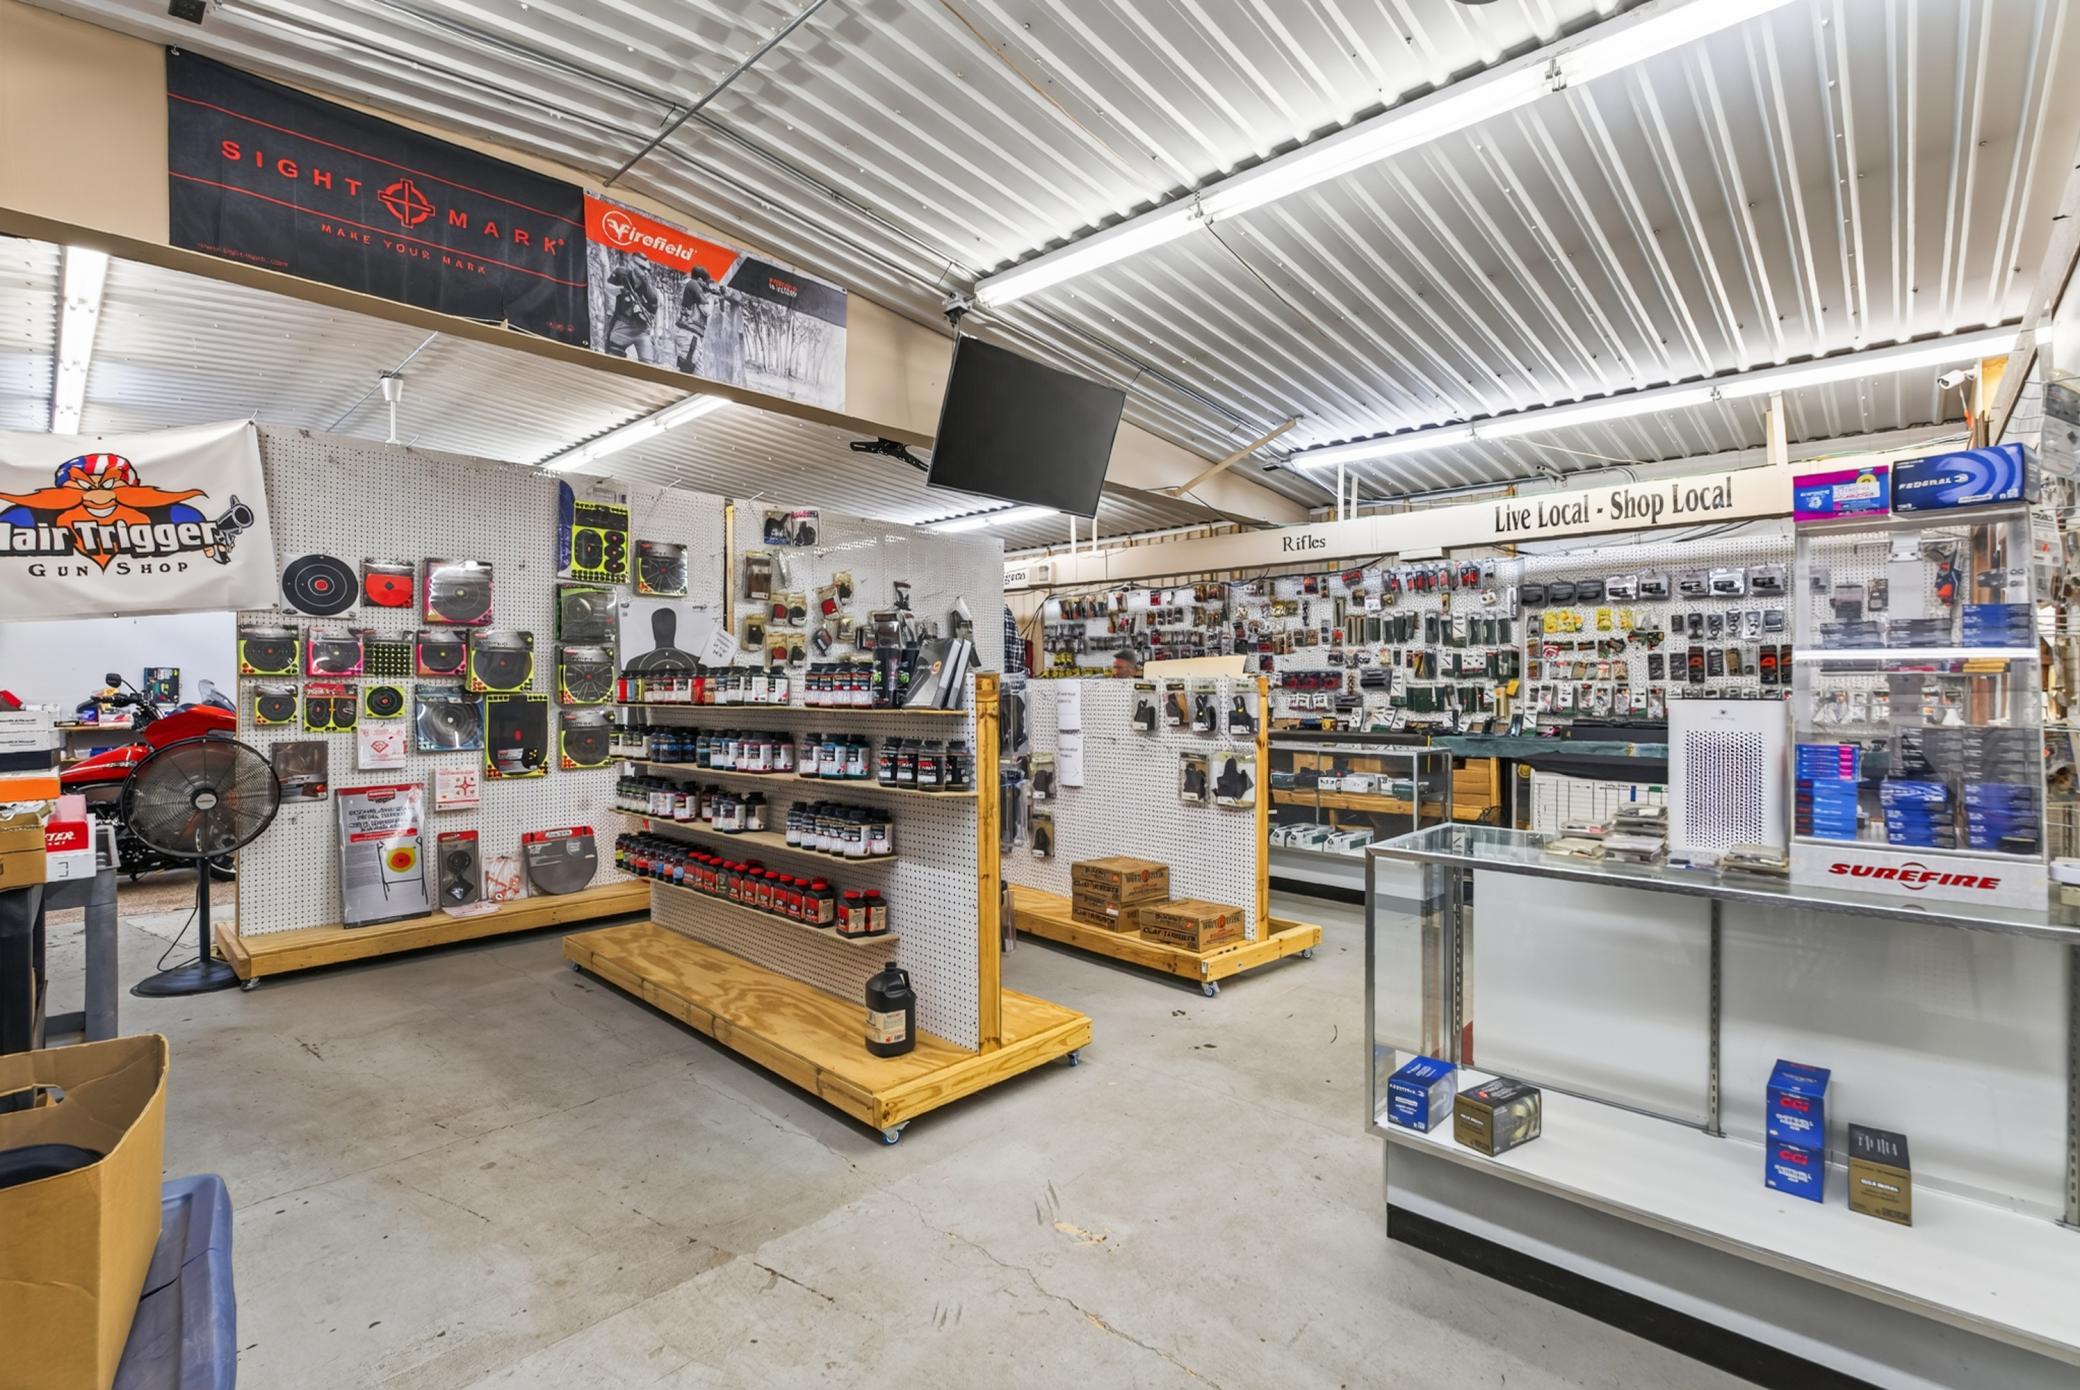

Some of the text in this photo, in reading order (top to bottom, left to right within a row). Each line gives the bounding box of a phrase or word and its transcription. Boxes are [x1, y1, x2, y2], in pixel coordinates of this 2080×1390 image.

[222, 140, 362, 196] SIGHT
[321, 223, 487, 274] MAKE YOUR MARK
[604, 210, 694, 261] Firefield
[1495, 506, 1531, 532] Live
[1538, 494, 1590, 528] Local
[1610, 488, 1664, 524] Shop
[1672, 476, 1733, 514] Local
[72, 519, 218, 557] Trigger
[1282, 535, 1326, 552] Rifles
[28, 562, 189, 577] GUN SHOP
[1828, 861, 2002, 890] SUREFIRE
